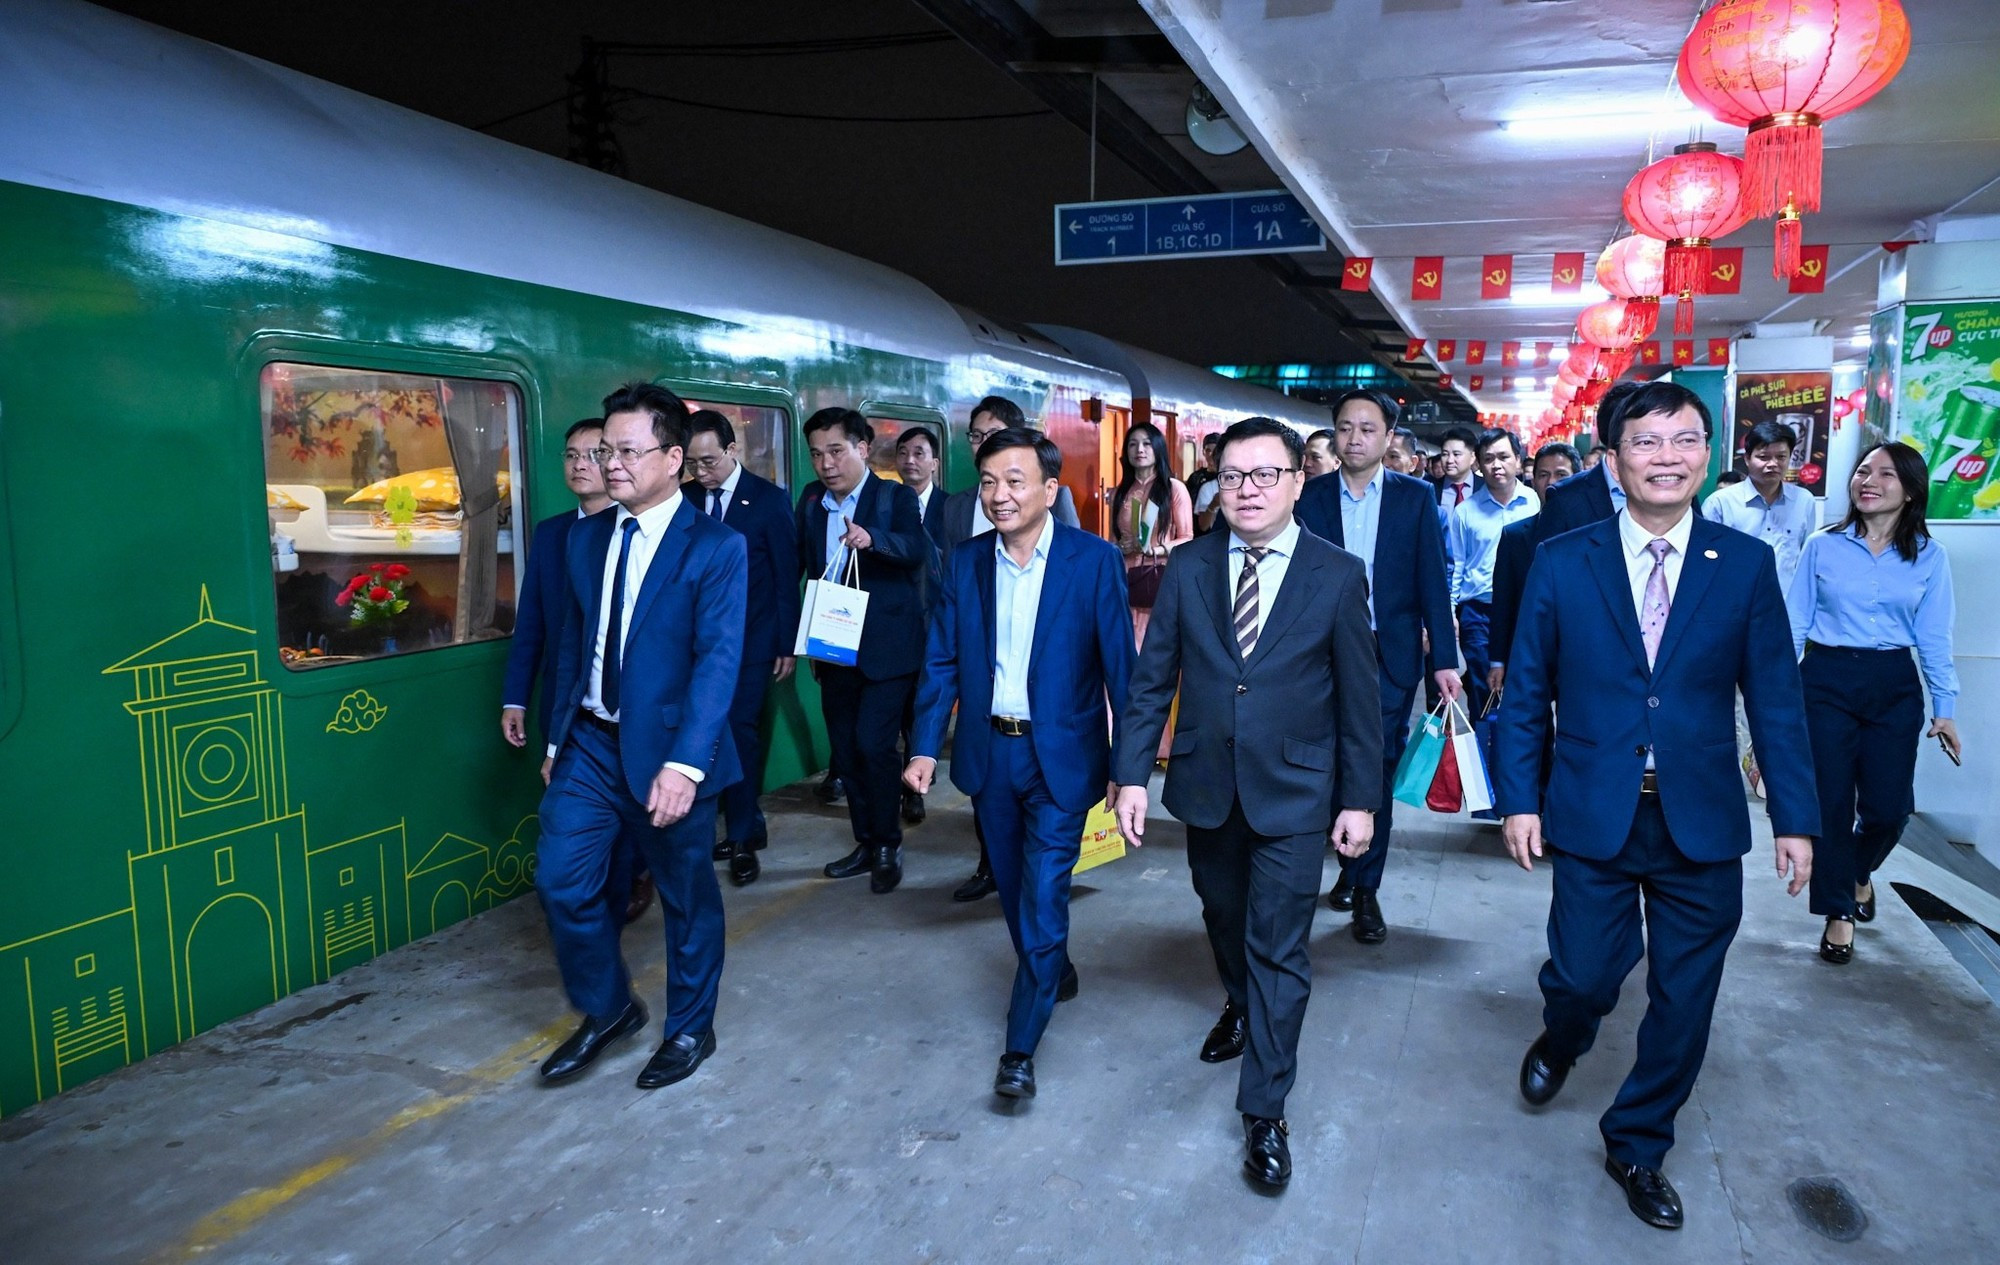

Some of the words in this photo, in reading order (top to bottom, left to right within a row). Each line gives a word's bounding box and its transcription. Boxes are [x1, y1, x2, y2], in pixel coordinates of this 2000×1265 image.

[1253, 219, 1283, 241] 1A
[1107, 235, 1116, 255] 1
[1958, 330, 1987, 344] CỰC
